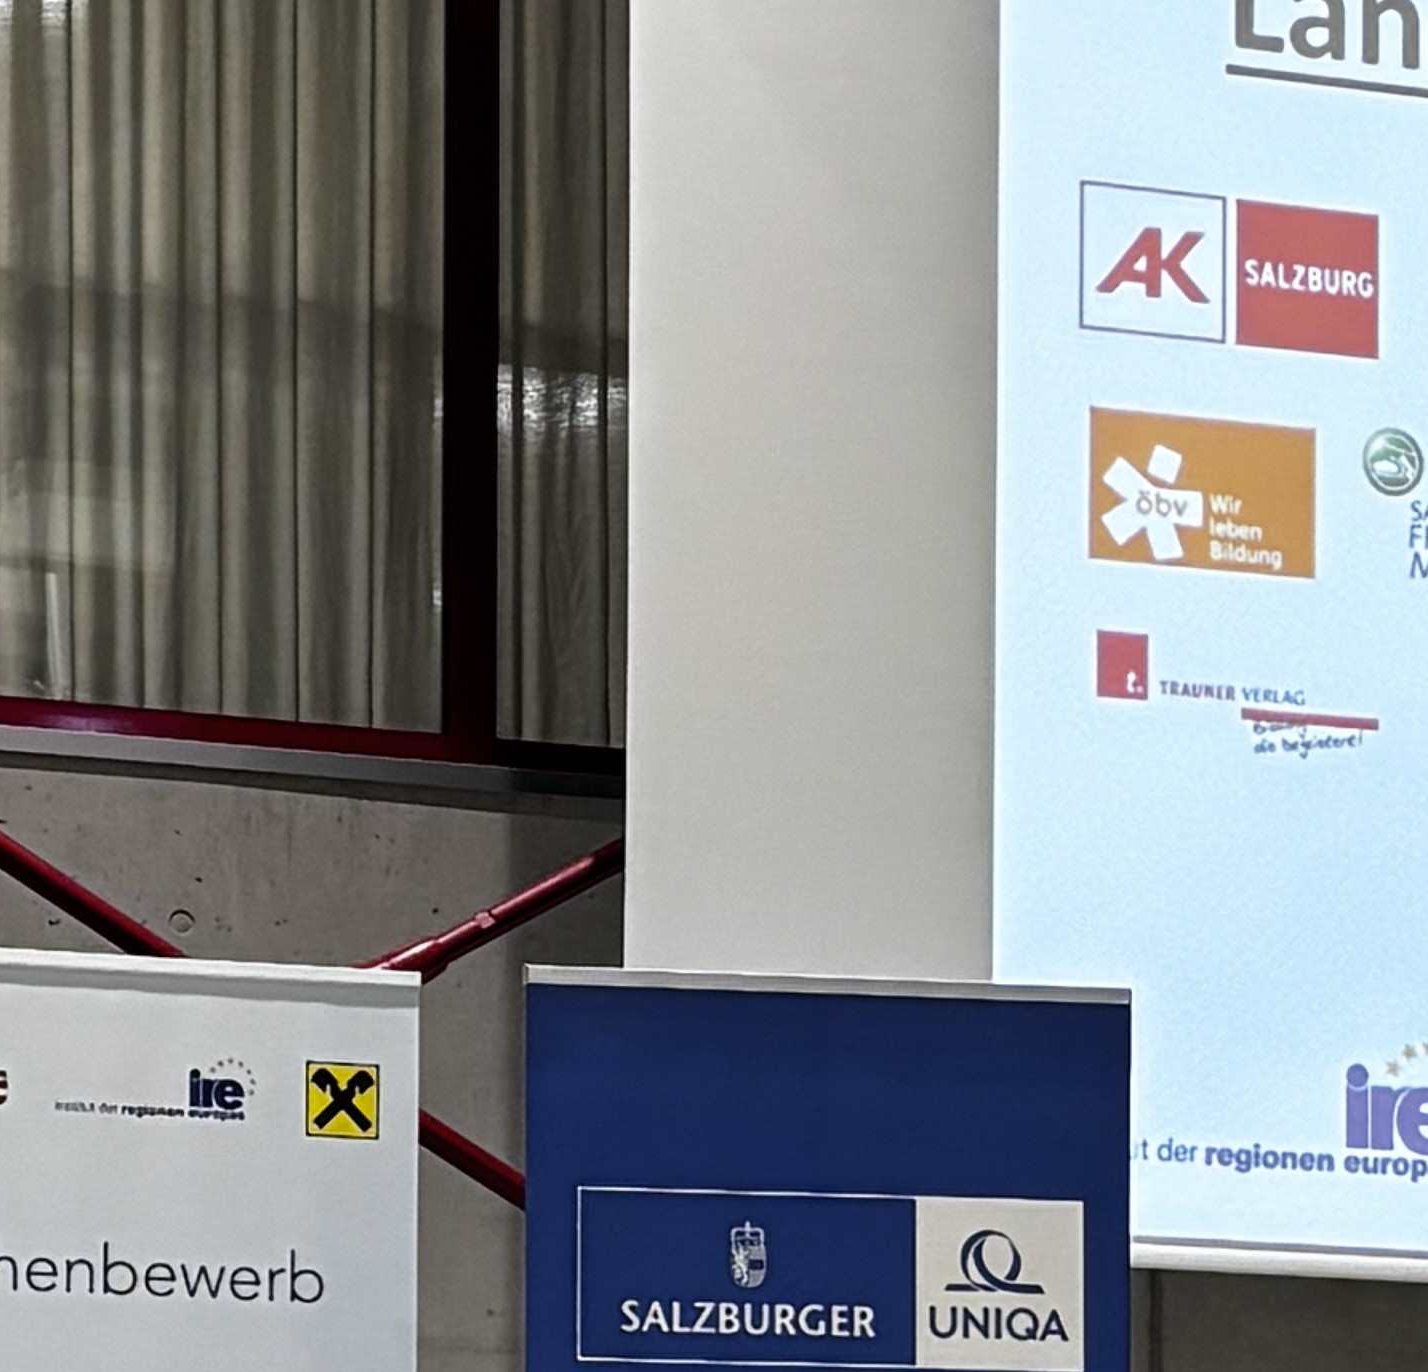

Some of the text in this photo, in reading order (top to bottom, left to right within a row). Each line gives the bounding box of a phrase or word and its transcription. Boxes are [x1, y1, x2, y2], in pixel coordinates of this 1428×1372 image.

[1095, 226, 1210, 304] AK
[1245, 258, 1373, 298] SALZBURG
[1135, 491, 1189, 517] öbv
[1209, 493, 1242, 515] Wir
[1209, 517, 1264, 542] leben
[1209, 540, 1283, 570] Bildung
[1160, 680, 1306, 706] TRAUNER VERLAG
[189, 1068, 246, 1110] ire
[1157, 1137, 1198, 1163] der
[1204, 1143, 1335, 1173] regionen
[620, 1300, 876, 1338] SALZBURGER
[928, 1305, 1069, 1342] UNIQA
